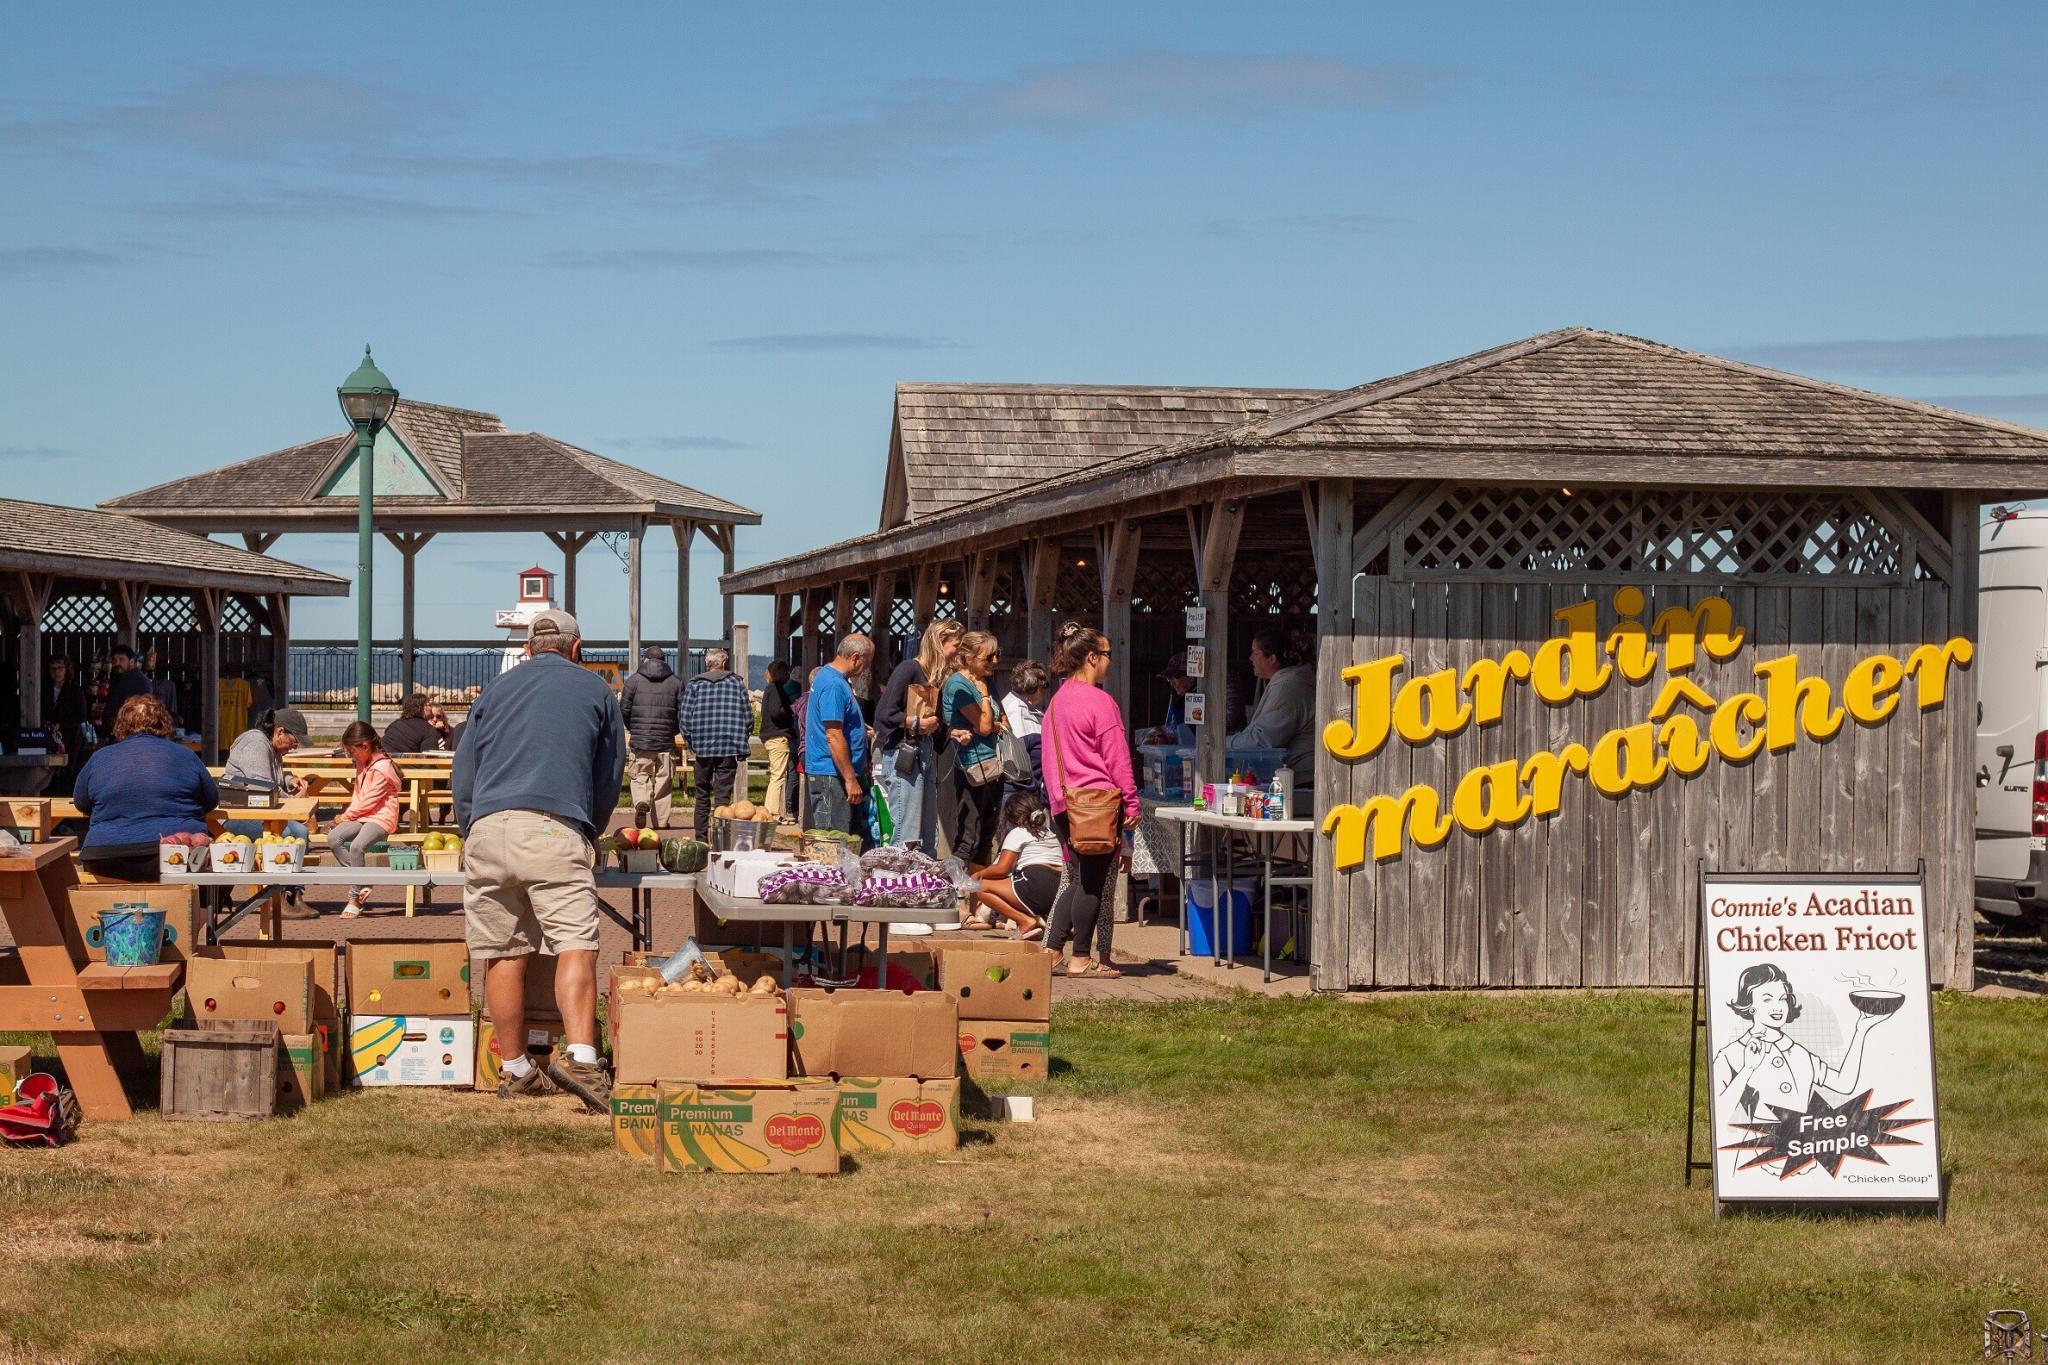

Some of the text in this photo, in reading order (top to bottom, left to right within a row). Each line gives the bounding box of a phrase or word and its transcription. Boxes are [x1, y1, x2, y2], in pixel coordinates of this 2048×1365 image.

[1322, 586, 1745, 761] Jardin
[1322, 637, 1973, 870] maraîcher
[1711, 889, 1915, 917] Connie's Acadian
[1716, 925, 1918, 952] Chicken Fricot
[1012, 1039, 1043, 1047] Premium
[620, 1101, 655, 1114] Prem
[670, 1107, 733, 1120] Premium
[894, 1111, 942, 1122] Del Monte
[1799, 1114, 1848, 1133] Free
[769, 1126, 821, 1137] Del Monte
[1787, 1131, 1869, 1157] Sample
[1843, 1174, 1933, 1184] "Chicken Soup"
